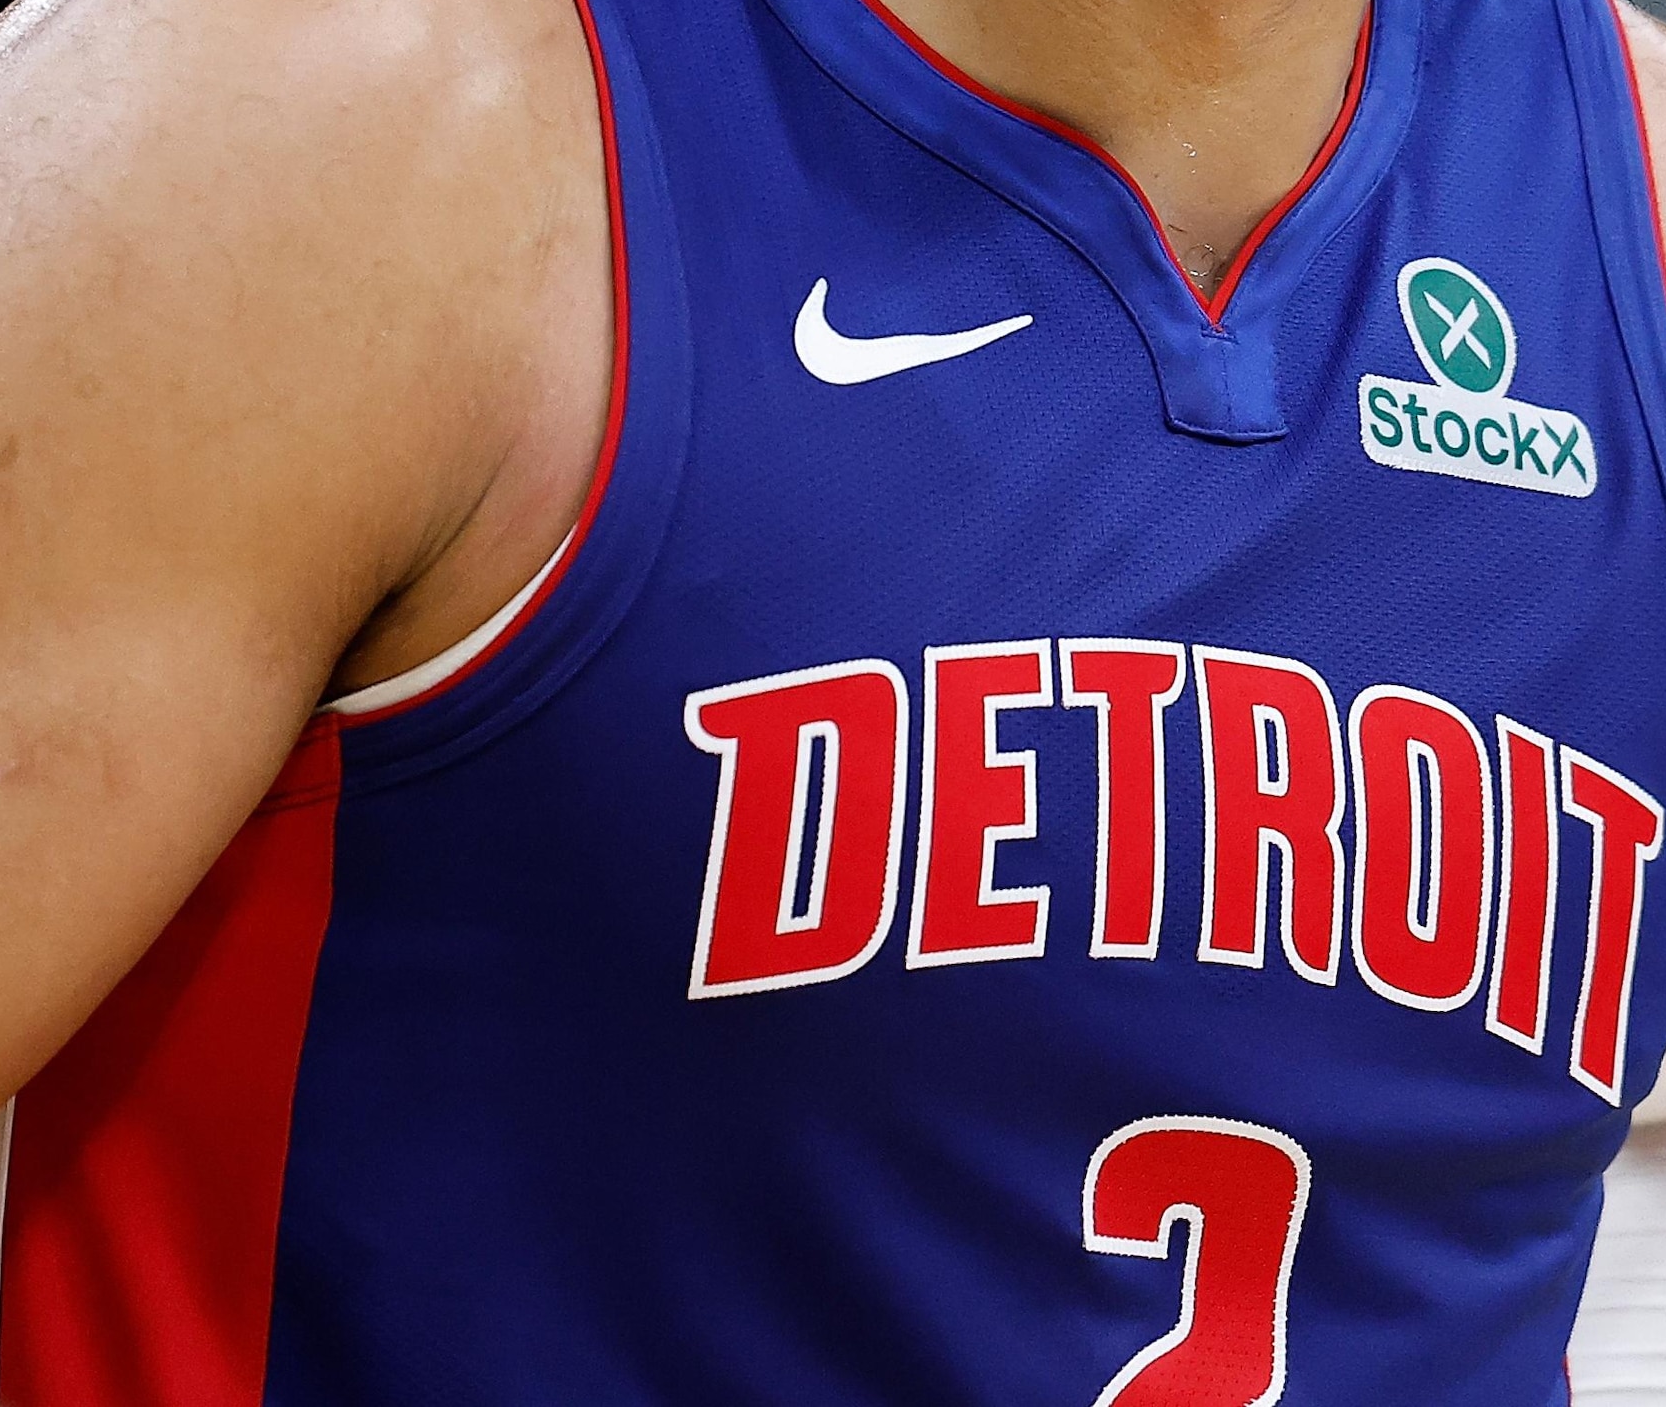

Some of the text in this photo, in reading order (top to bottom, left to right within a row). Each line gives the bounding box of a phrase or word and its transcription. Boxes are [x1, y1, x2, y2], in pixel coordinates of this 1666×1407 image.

[1368, 387, 1587, 483] StockX
[684, 637, 1664, 1108] DETROIT
[1083, 1113, 1312, 1407] 2
